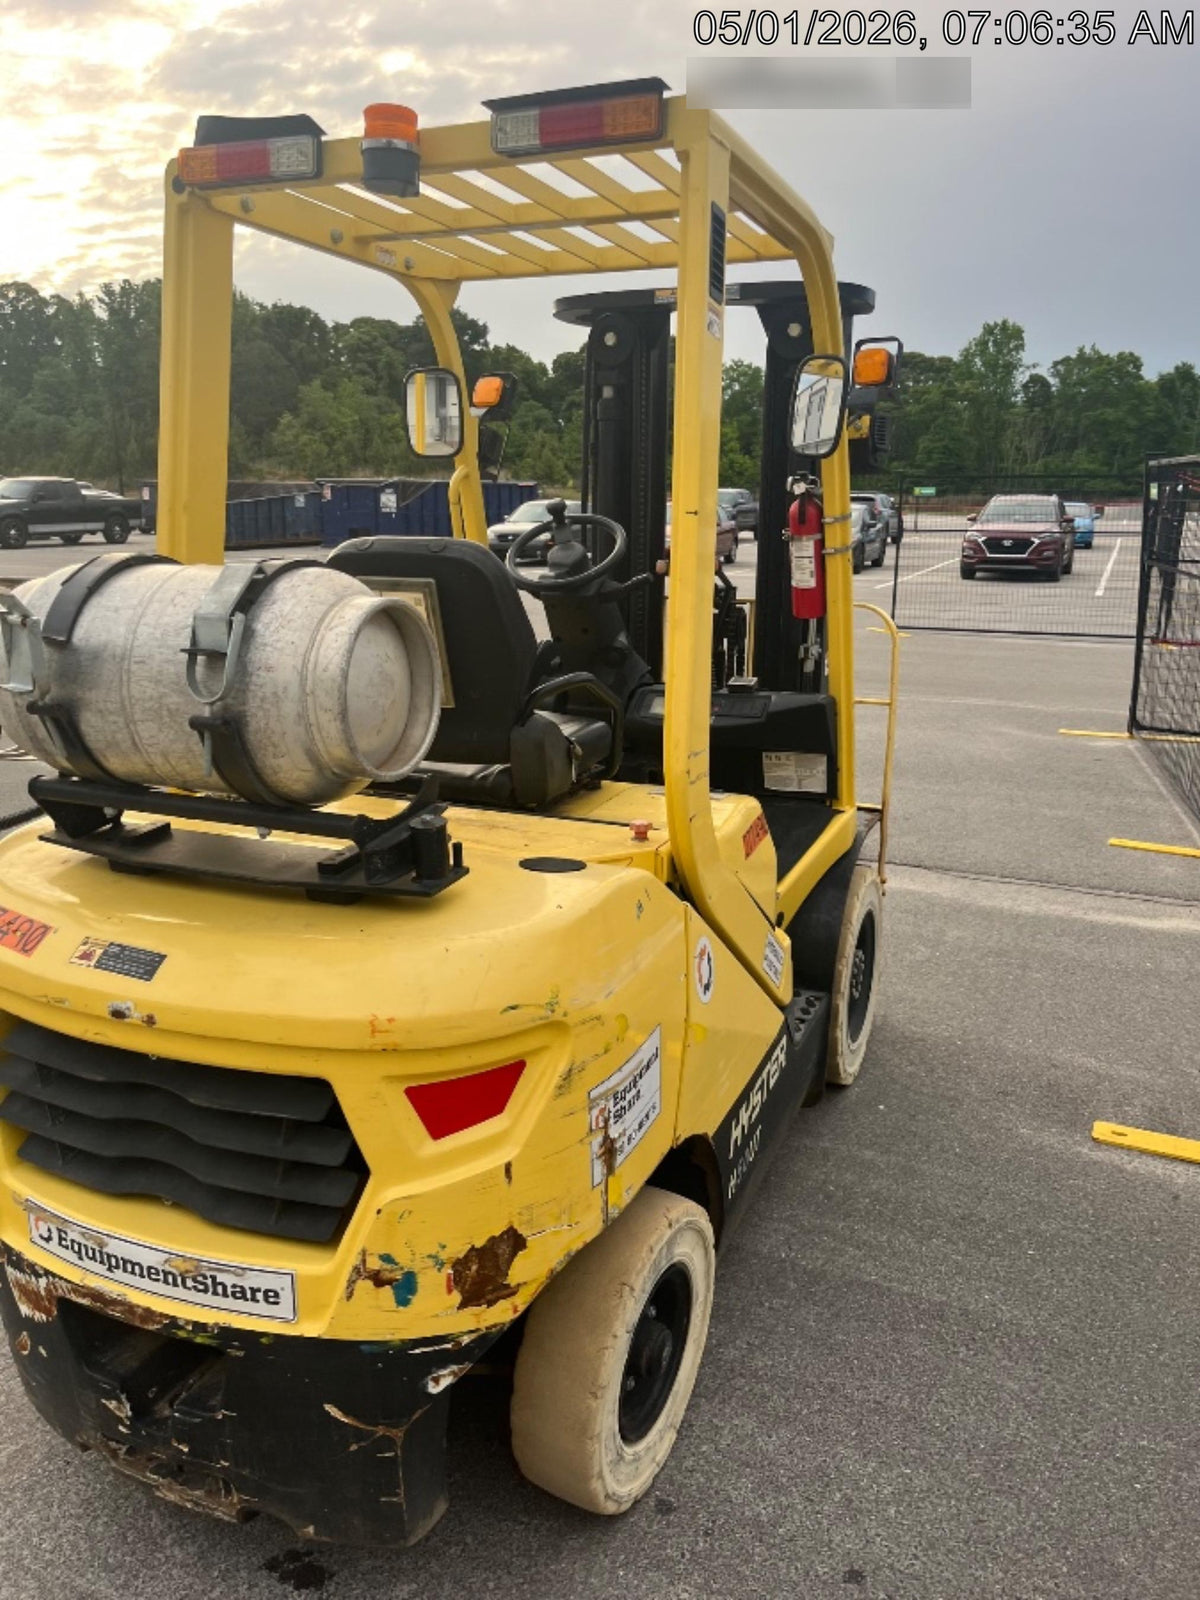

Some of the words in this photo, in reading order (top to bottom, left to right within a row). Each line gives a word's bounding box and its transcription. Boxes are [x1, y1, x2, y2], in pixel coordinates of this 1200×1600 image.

[612, 1088, 642, 1125] Share
[728, 1033, 788, 1160] HYSTER
[55, 1226, 283, 1306] EquipmentShare
